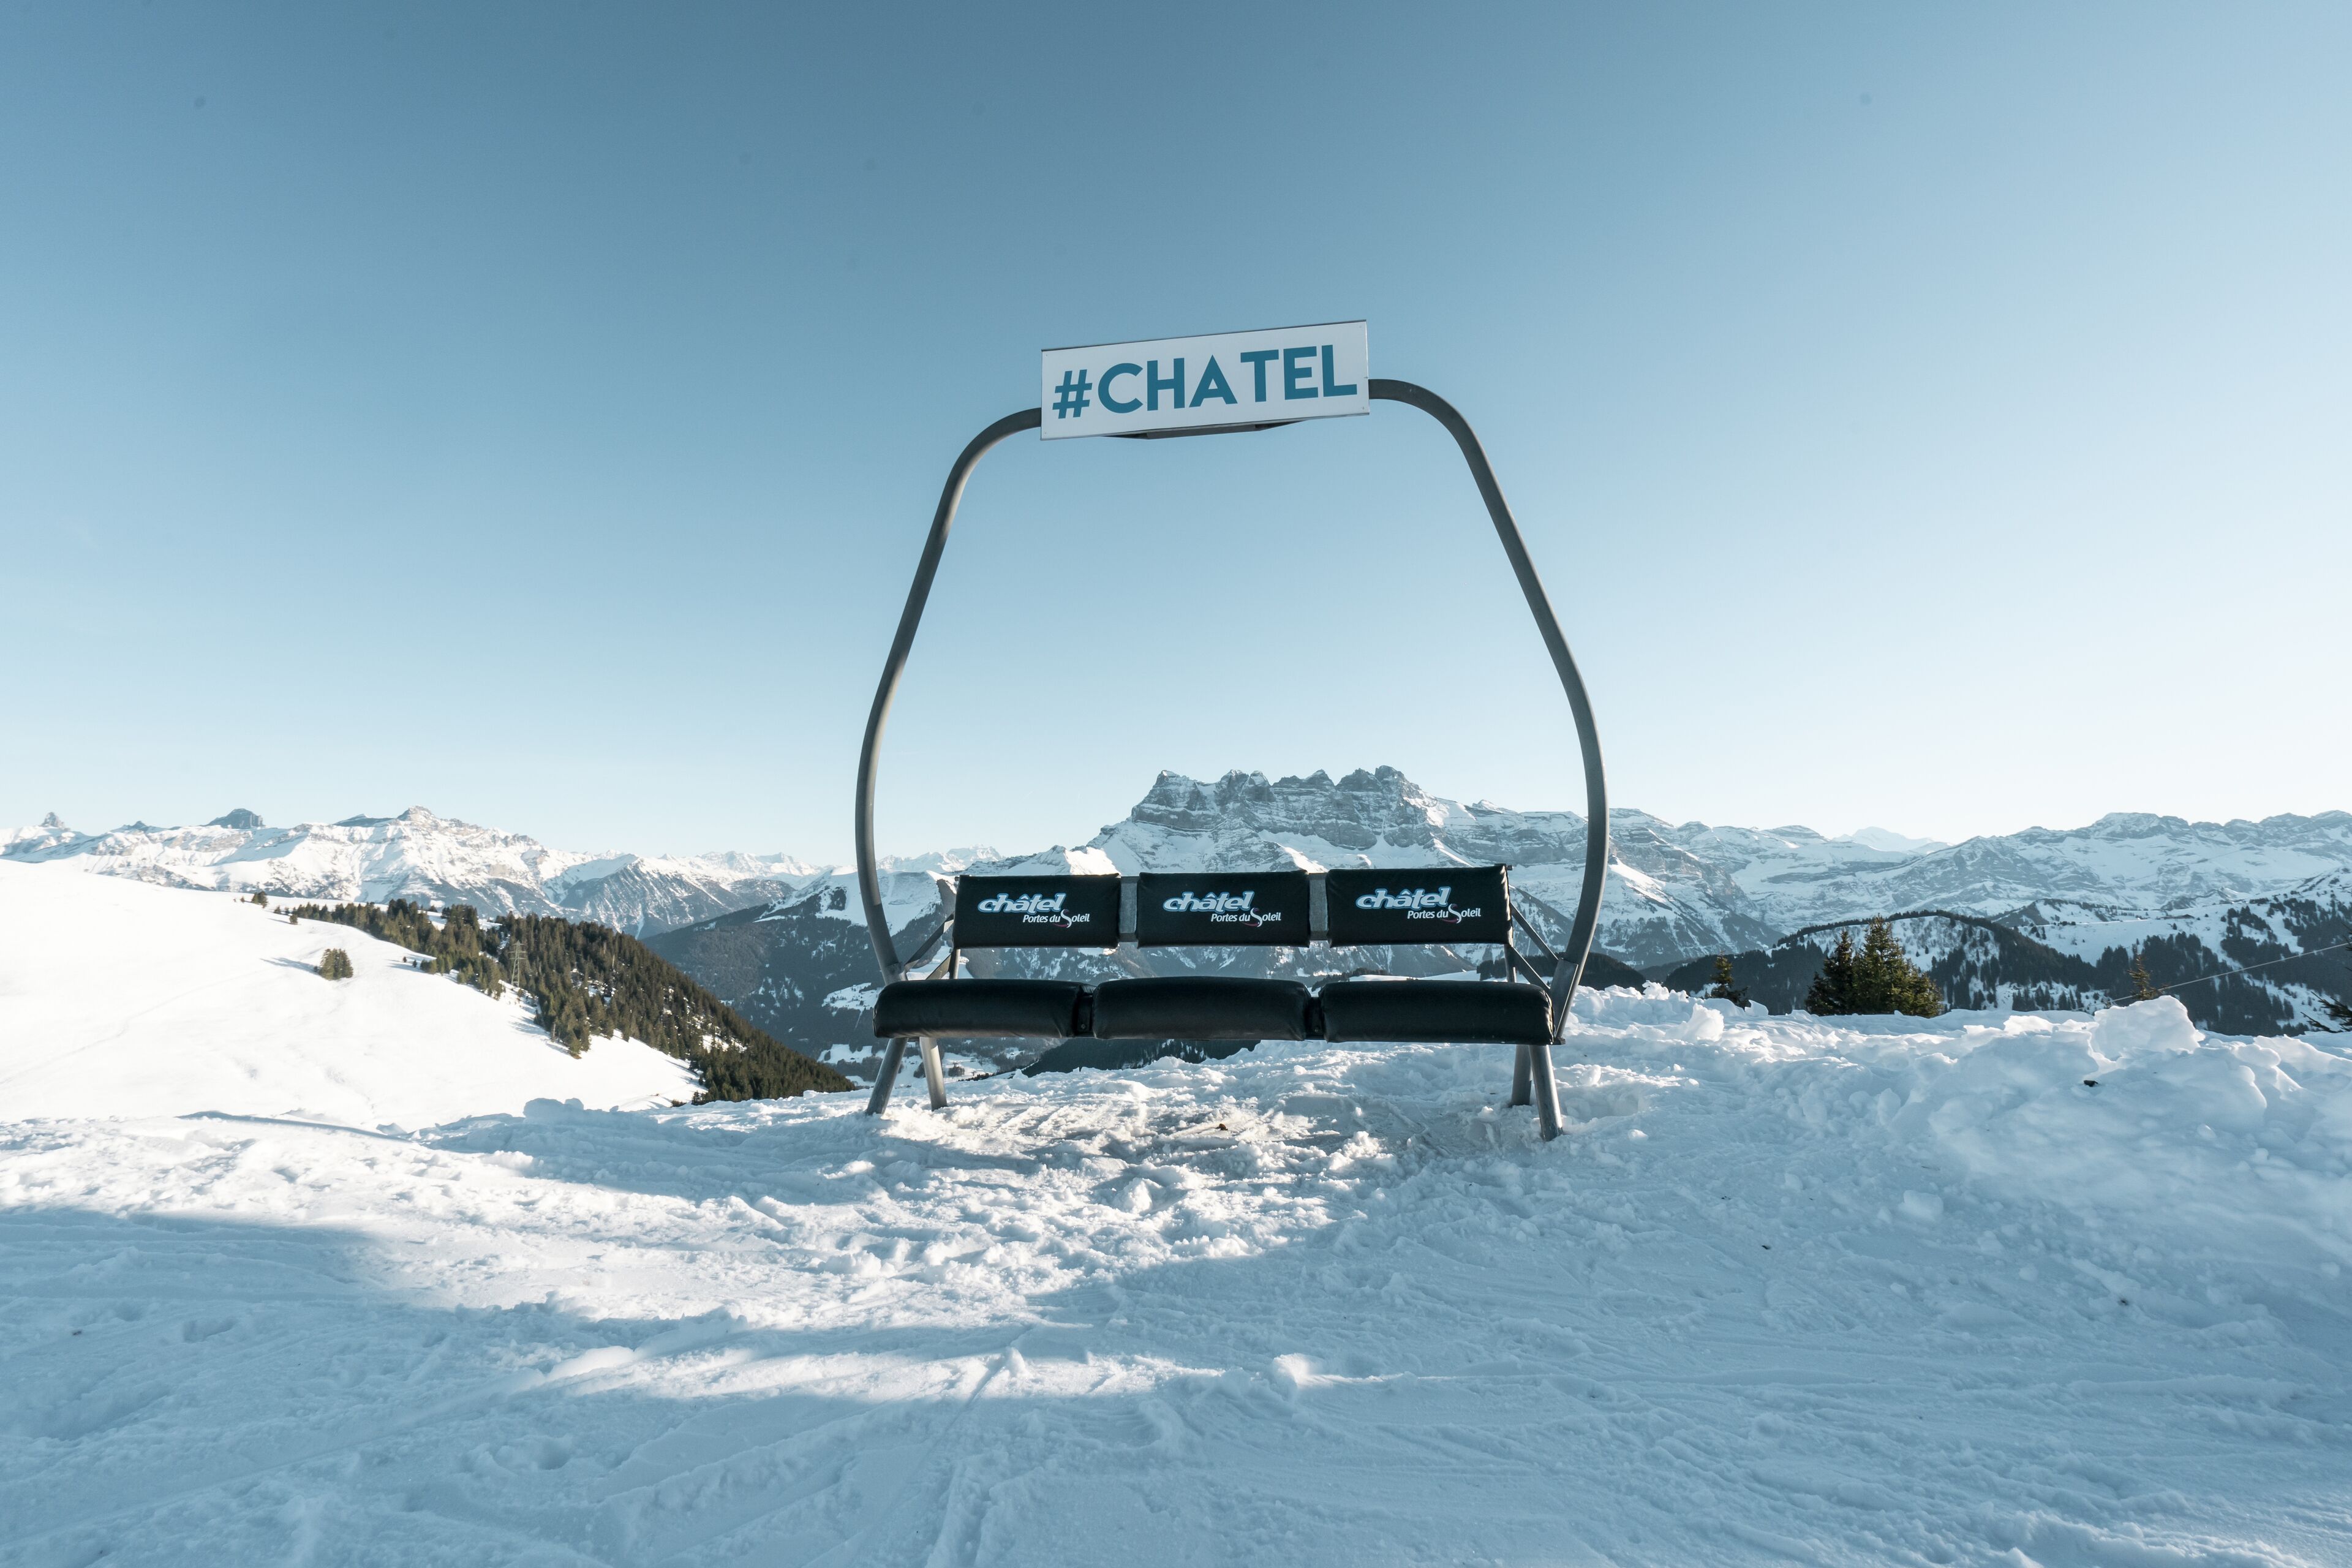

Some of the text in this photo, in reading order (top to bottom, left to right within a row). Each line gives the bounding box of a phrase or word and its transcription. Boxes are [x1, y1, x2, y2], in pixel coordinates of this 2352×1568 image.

[1052, 344, 1357, 419] #CHATEL
[978, 893, 1066, 914] châtel
[1163, 891, 1254, 913] châtel
[1355, 886, 1451, 911] châtel
[1023, 909, 1090, 929] Portes du Soleil
[1210, 907, 1281, 927] Portes du Soleil
[1408, 903, 1481, 924] Portes du Soleil
